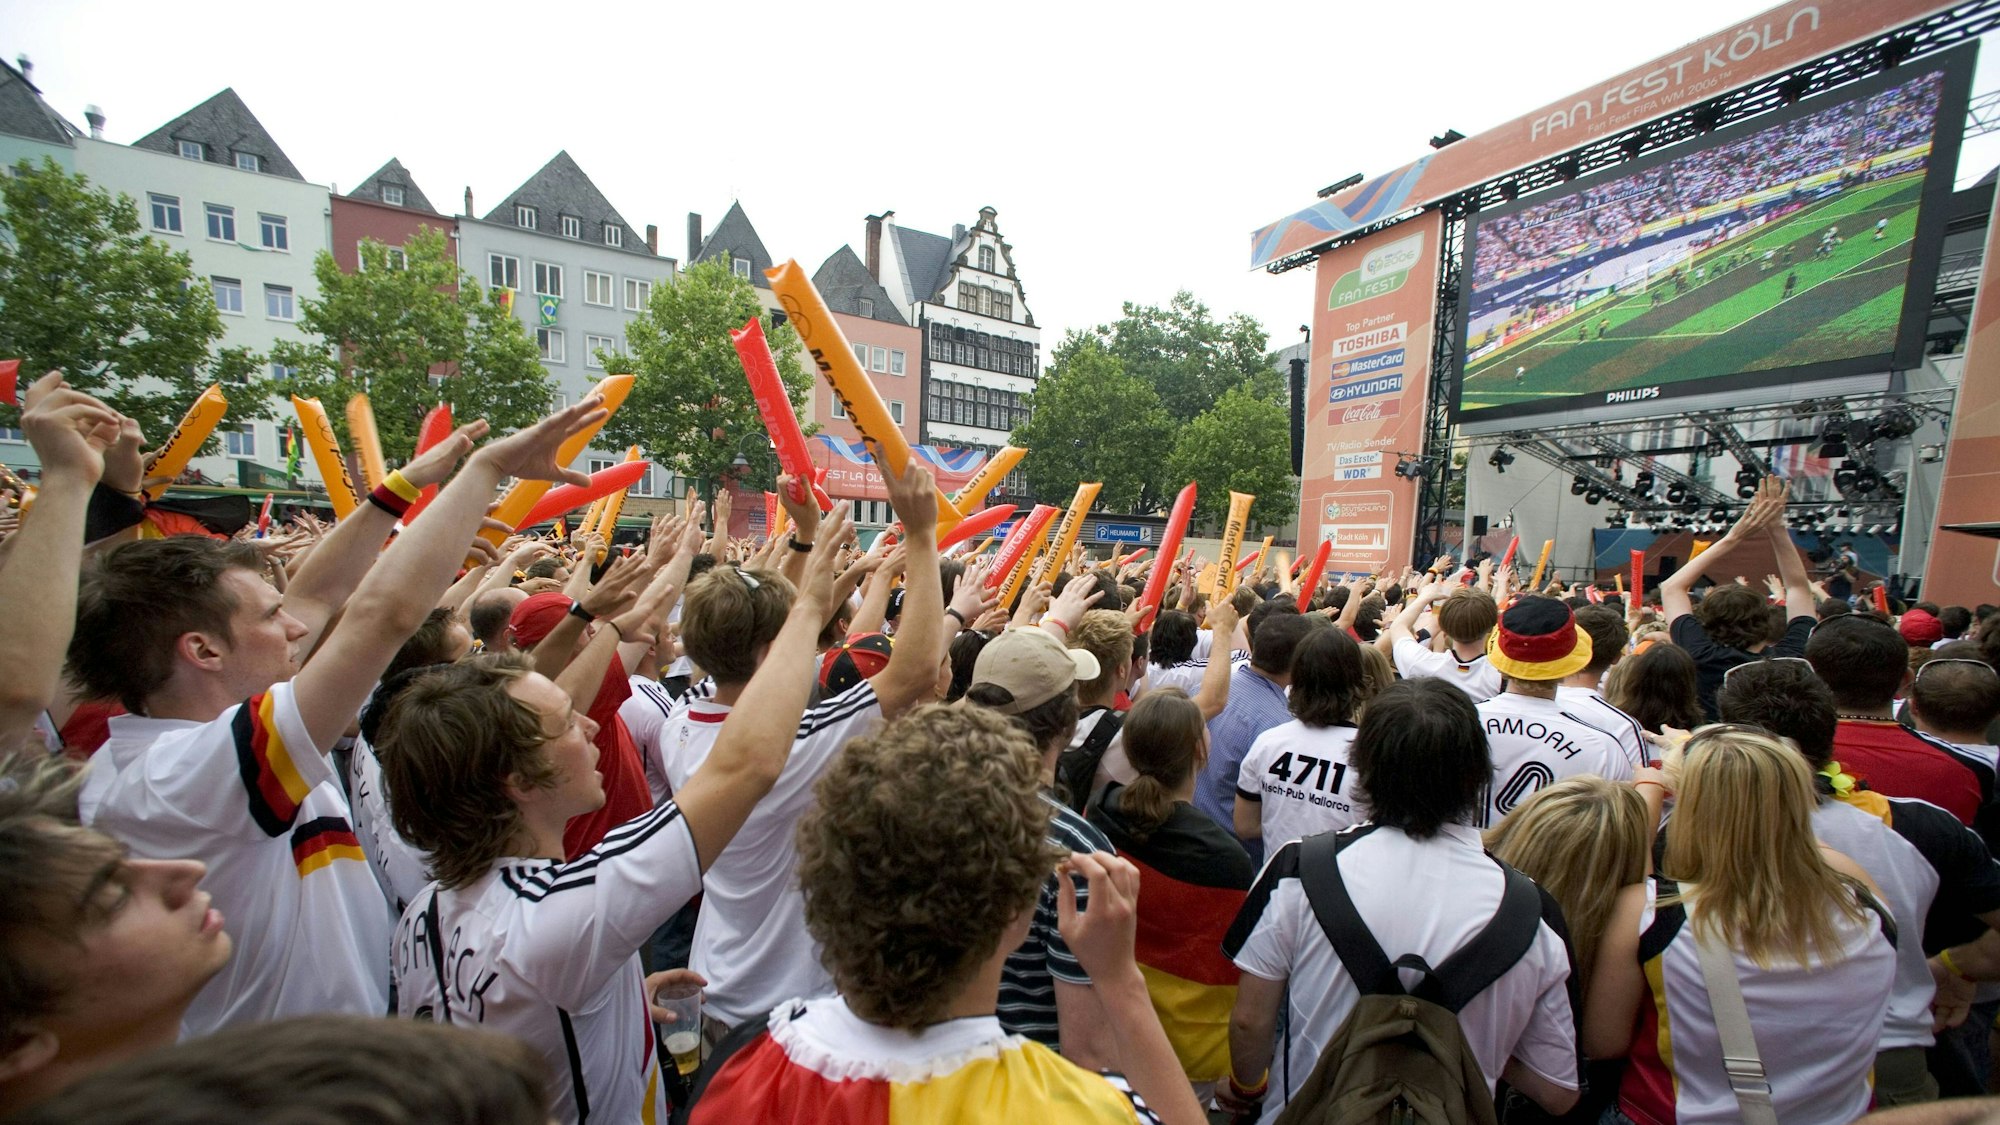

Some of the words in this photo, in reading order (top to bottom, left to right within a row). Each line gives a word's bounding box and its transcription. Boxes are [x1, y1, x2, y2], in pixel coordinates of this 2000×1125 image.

[1530, 101, 1592, 142] FAN
[1601, 55, 1693, 114] FEST
[1702, 6, 1820, 73] KÖLN
[1587, 121, 1607, 134] Fan
[1609, 110, 1632, 124] Fest
[1633, 101, 1658, 116] FIFA
[1660, 89, 1685, 105] WM
[1338, 287, 1361, 305] FAN
[1364, 275, 1397, 295] FEST
[1346, 322, 1360, 332] Top
[1363, 312, 1395, 327] Partner
[1338, 327, 1400, 353] TOSHIBA
[1350, 351, 1404, 373] MasterCard
[1346, 376, 1402, 397] HYUNDAI
[1606, 386, 1660, 403] PHILIPS
[1327, 441, 1362, 451] TV/Radio
[1364, 436, 1397, 448] Sender
[1339, 456, 1353, 465] Das
[849, 471, 863, 481] LA
[1343, 468, 1367, 479] WDR
[1042, 509, 1078, 574] MasterCard
[1109, 529, 1139, 537] HEUMARKT
[1337, 533, 1354, 541] Stadt
[1354, 532, 1369, 541] Köln
[992, 521, 1034, 578] MasterCard
[1217, 519, 1241, 590] MasterCard
[1268, 751, 1347, 795] 4711
[1308, 792, 1350, 813] Mallorca
